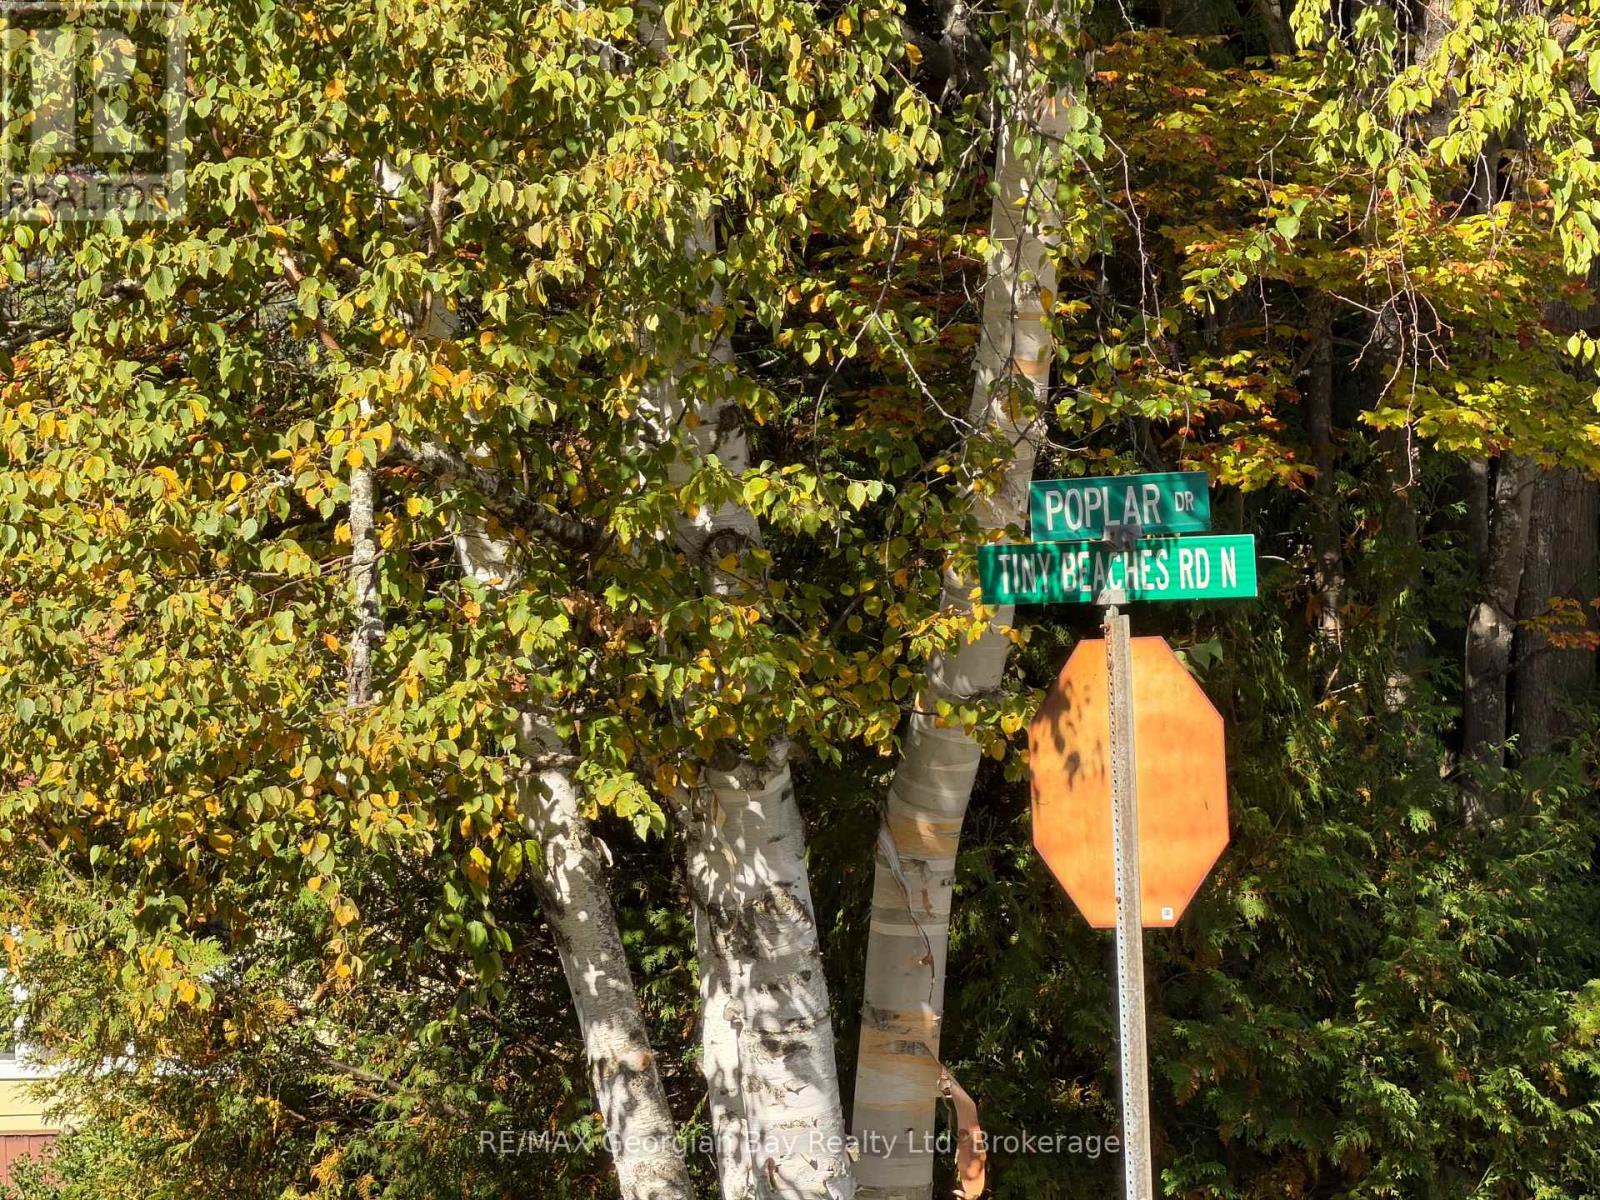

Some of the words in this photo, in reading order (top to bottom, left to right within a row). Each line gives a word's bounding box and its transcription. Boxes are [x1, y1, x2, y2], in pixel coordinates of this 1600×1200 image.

[1045, 484, 1162, 531] POPLAR
[1174, 491, 1194, 512] DR
[998, 552, 1050, 594] TINY
[1061, 548, 1170, 593] BEACHES
[1179, 547, 1210, 590] RD
[1221, 547, 1236, 589] N
